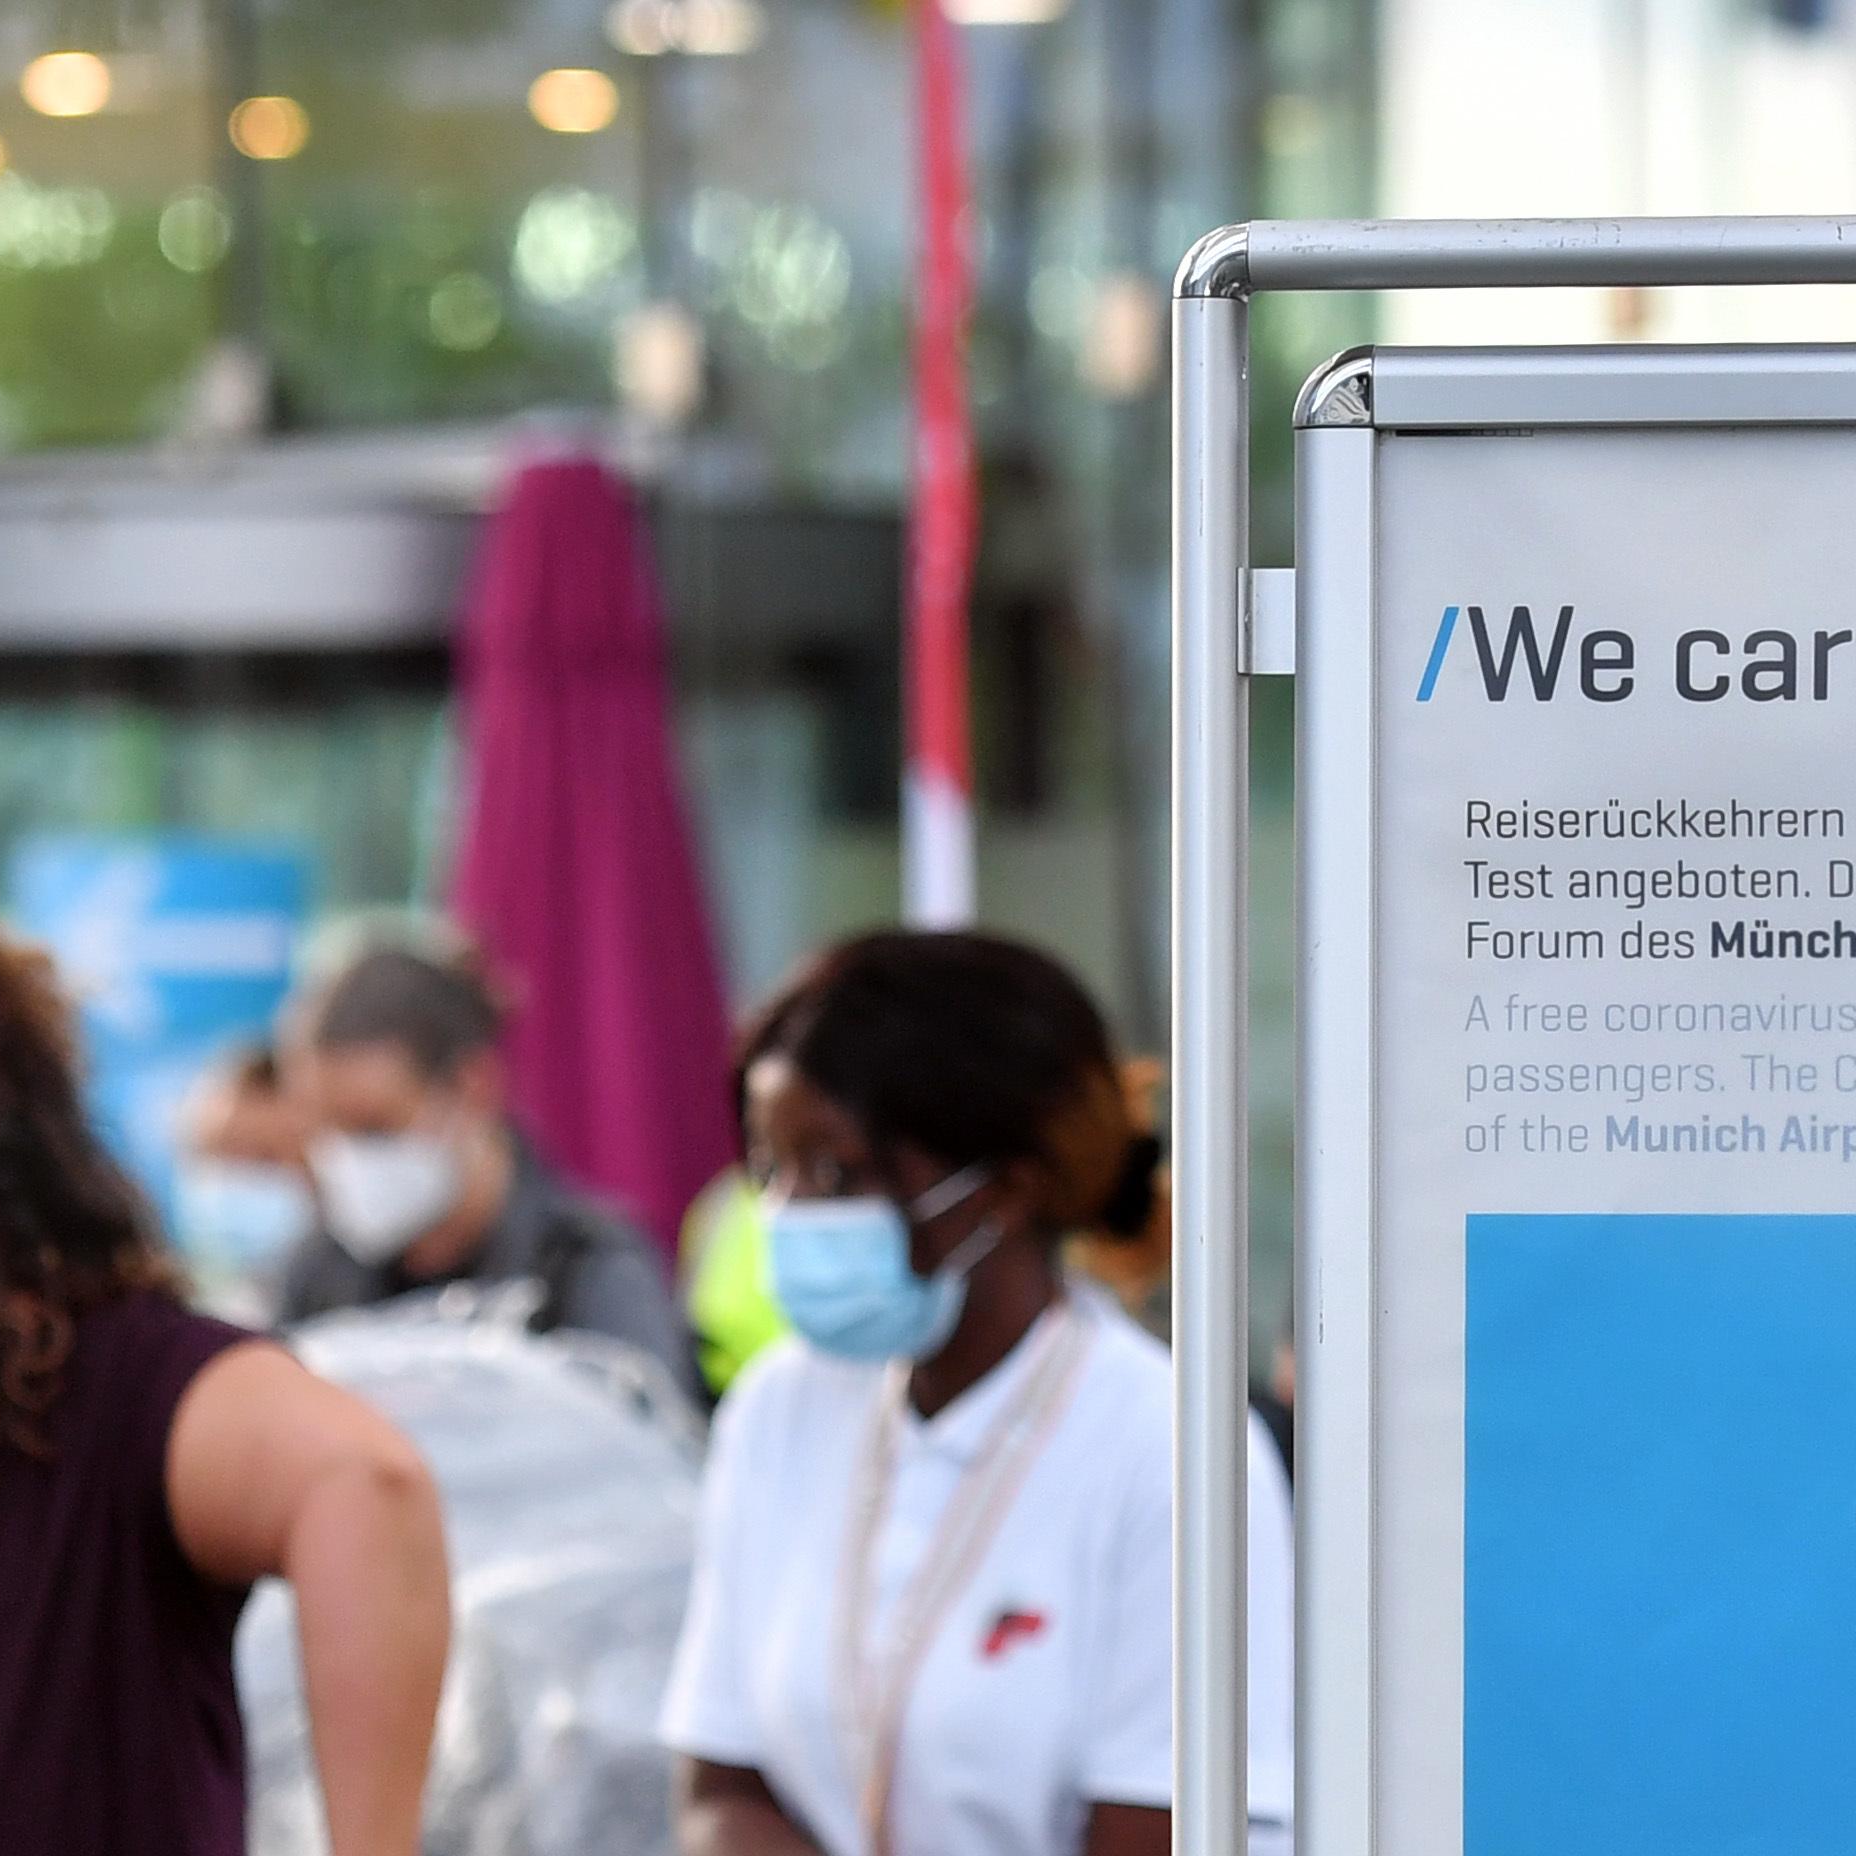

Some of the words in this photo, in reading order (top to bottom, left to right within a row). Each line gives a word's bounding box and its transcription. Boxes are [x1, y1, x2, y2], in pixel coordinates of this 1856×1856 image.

[1466, 799, 1845, 839] Reiserückkehrern
[1465, 861, 1554, 901] Test
[1569, 860, 1811, 911] angeboten.
[1467, 922, 1605, 961] Forum
[1621, 921, 1696, 961] des
[1464, 996, 1492, 1034] A
[1505, 995, 1590, 1034] free
[1466, 1062, 1726, 1105] passengers.
[1741, 1055, 1819, 1094] The
[1465, 1114, 1507, 1154] of
[1520, 1114, 1590, 1154] the
[1605, 1114, 1767, 1154] Munich
